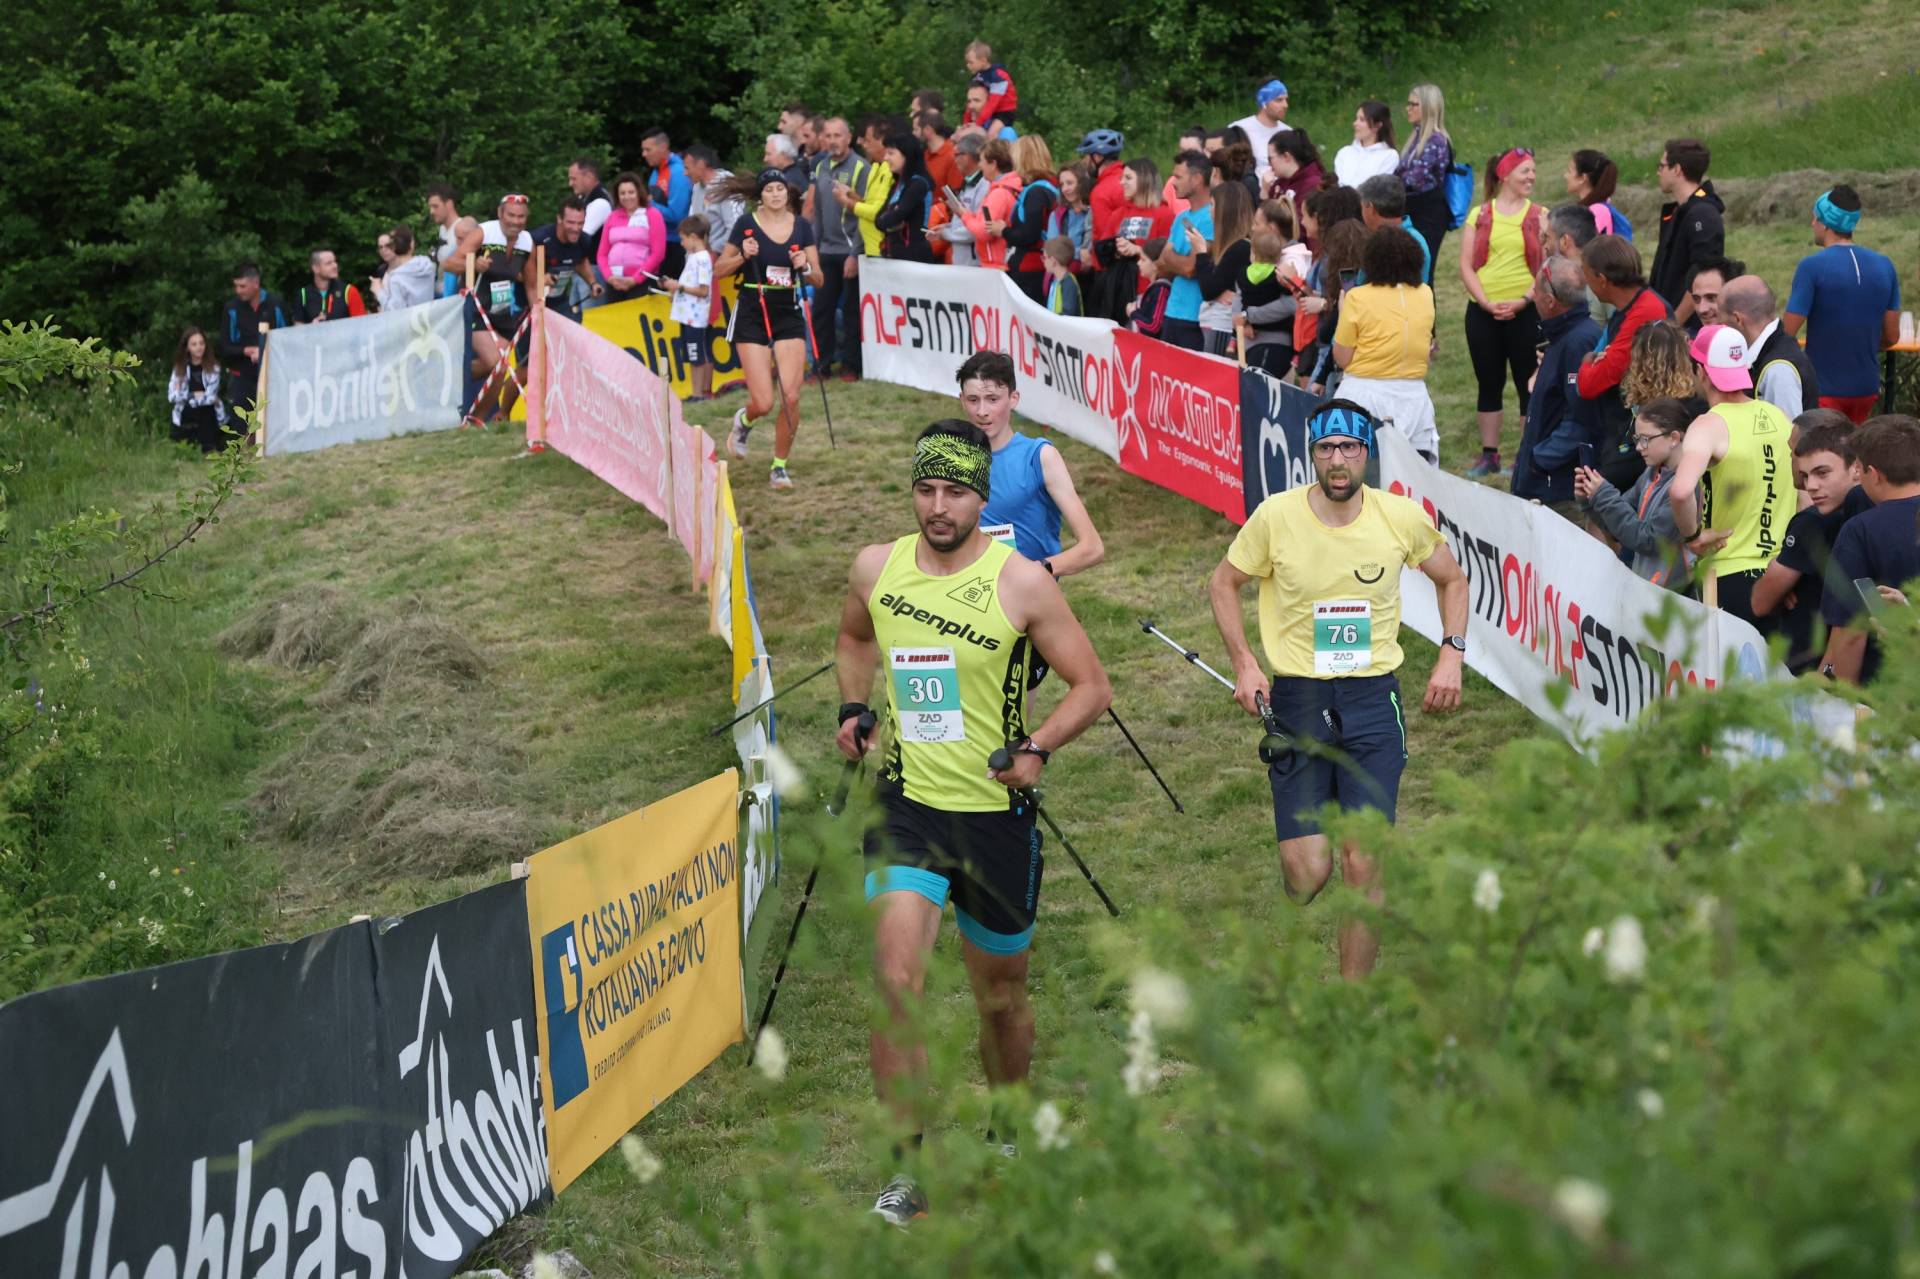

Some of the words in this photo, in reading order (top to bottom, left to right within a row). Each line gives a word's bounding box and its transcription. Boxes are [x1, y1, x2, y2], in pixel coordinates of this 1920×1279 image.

[1157, 440, 1171, 456] The
[1174, 447, 1213, 475] Ergonomic
[879, 592, 1001, 652] alpenplus
[1327, 624, 1359, 645] 76
[907, 676, 945, 704] 30
[581, 898, 631, 967] CASSA
[672, 862, 694, 912] VAL
[692, 851, 708, 901] DI
[706, 838, 736, 894] NON
[584, 948, 660, 1039] ROTALIANA
[657, 940, 667, 988] E
[667, 916, 706, 983] GIOVO
[594, 1051, 616, 1081] CREDITO
[645, 1007, 671, 1036] ITALIANO
